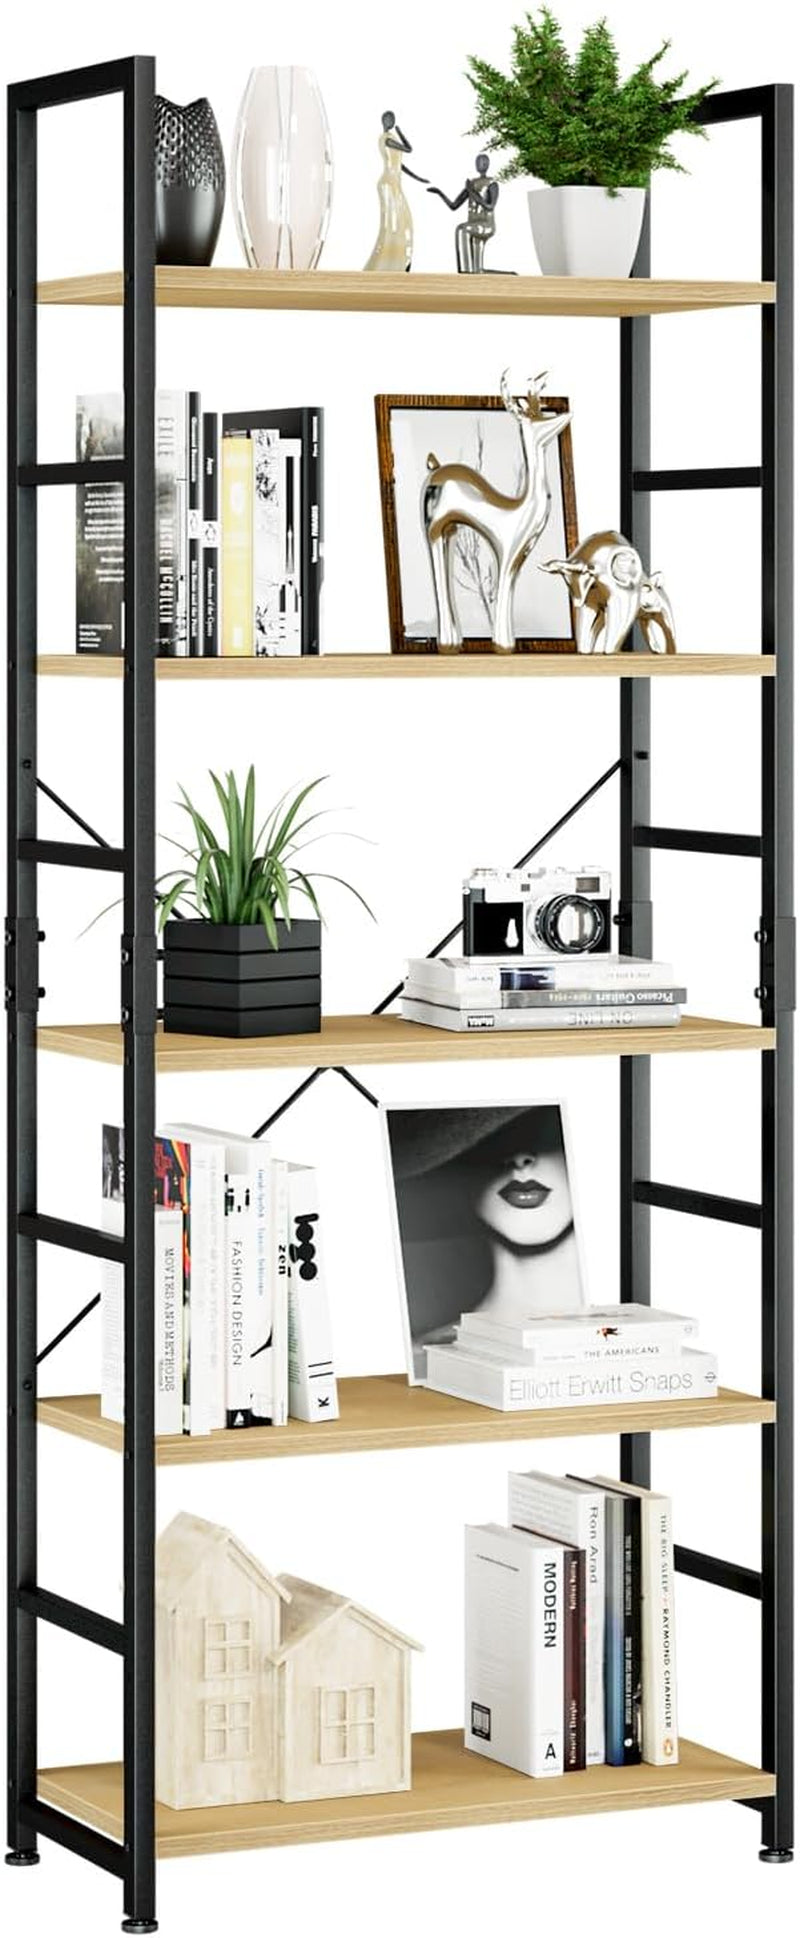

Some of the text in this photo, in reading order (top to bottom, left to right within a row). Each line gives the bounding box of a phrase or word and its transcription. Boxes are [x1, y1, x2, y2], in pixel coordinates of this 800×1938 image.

[157, 416, 174, 457] EXILE
[158, 518, 174, 561] RACHEL
[595, 992, 635, 1004] Guitars
[636, 991, 674, 1003] Picasso
[278, 1244, 287, 1275] zen
[287, 1212, 320, 1282] logo
[164, 1248, 175, 1391] MOVIES AND METHODS
[232, 1240, 243, 1366] FASHION DESIGN
[584, 1350, 601, 1359] THE
[605, 1346, 660, 1357] AMERICANS
[509, 1370, 693, 1401] Elliott Erwitt Snaps
[589, 1506, 599, 1583] Ron Arad
[661, 1562, 669, 1593] SLEEP
[543, 1562, 557, 1648] MODERN
[662, 1608, 670, 1666] RAYMOND
[663, 1670, 672, 1728] CHANDLER
[544, 1743, 557, 1760] A
